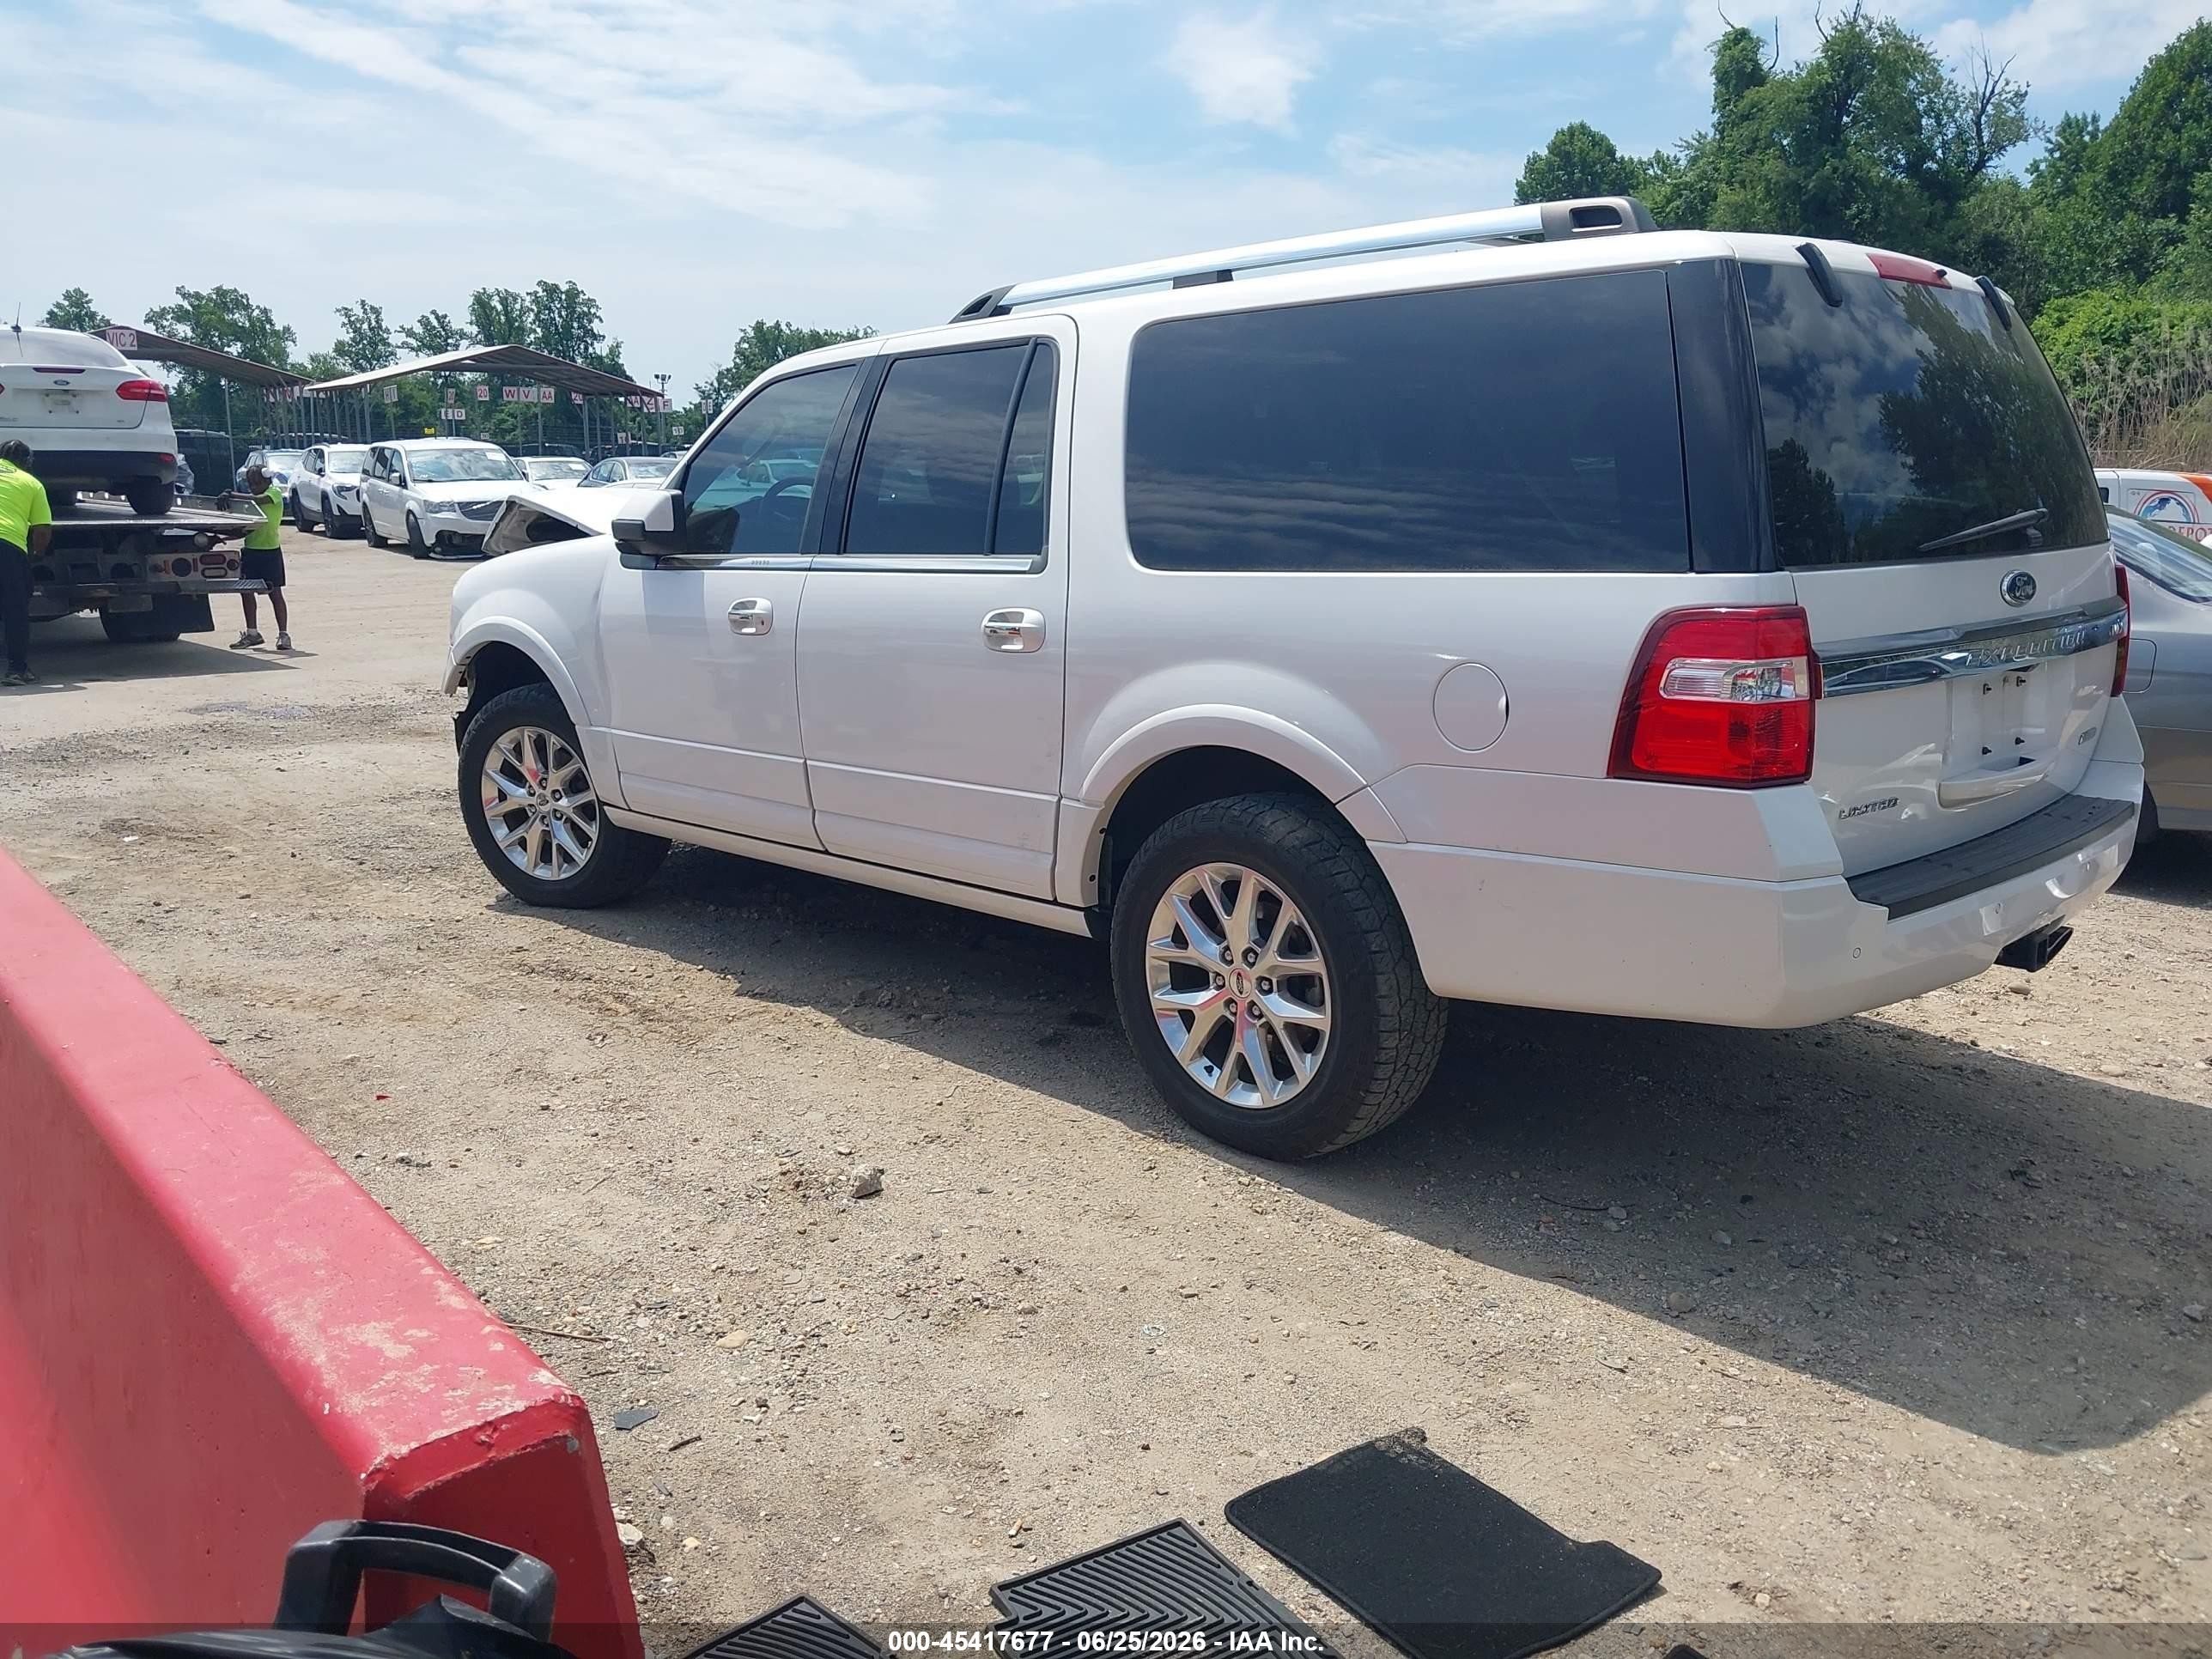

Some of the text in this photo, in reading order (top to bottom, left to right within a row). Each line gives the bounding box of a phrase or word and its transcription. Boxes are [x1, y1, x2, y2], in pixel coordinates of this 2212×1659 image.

[107, 331, 136, 347] VIC 2
[477, 388, 488, 398] 20
[505, 389, 515, 398] W
[522, 390, 531, 399] V
[543, 391, 553, 400] AA
[663, 400, 669, 410] F
